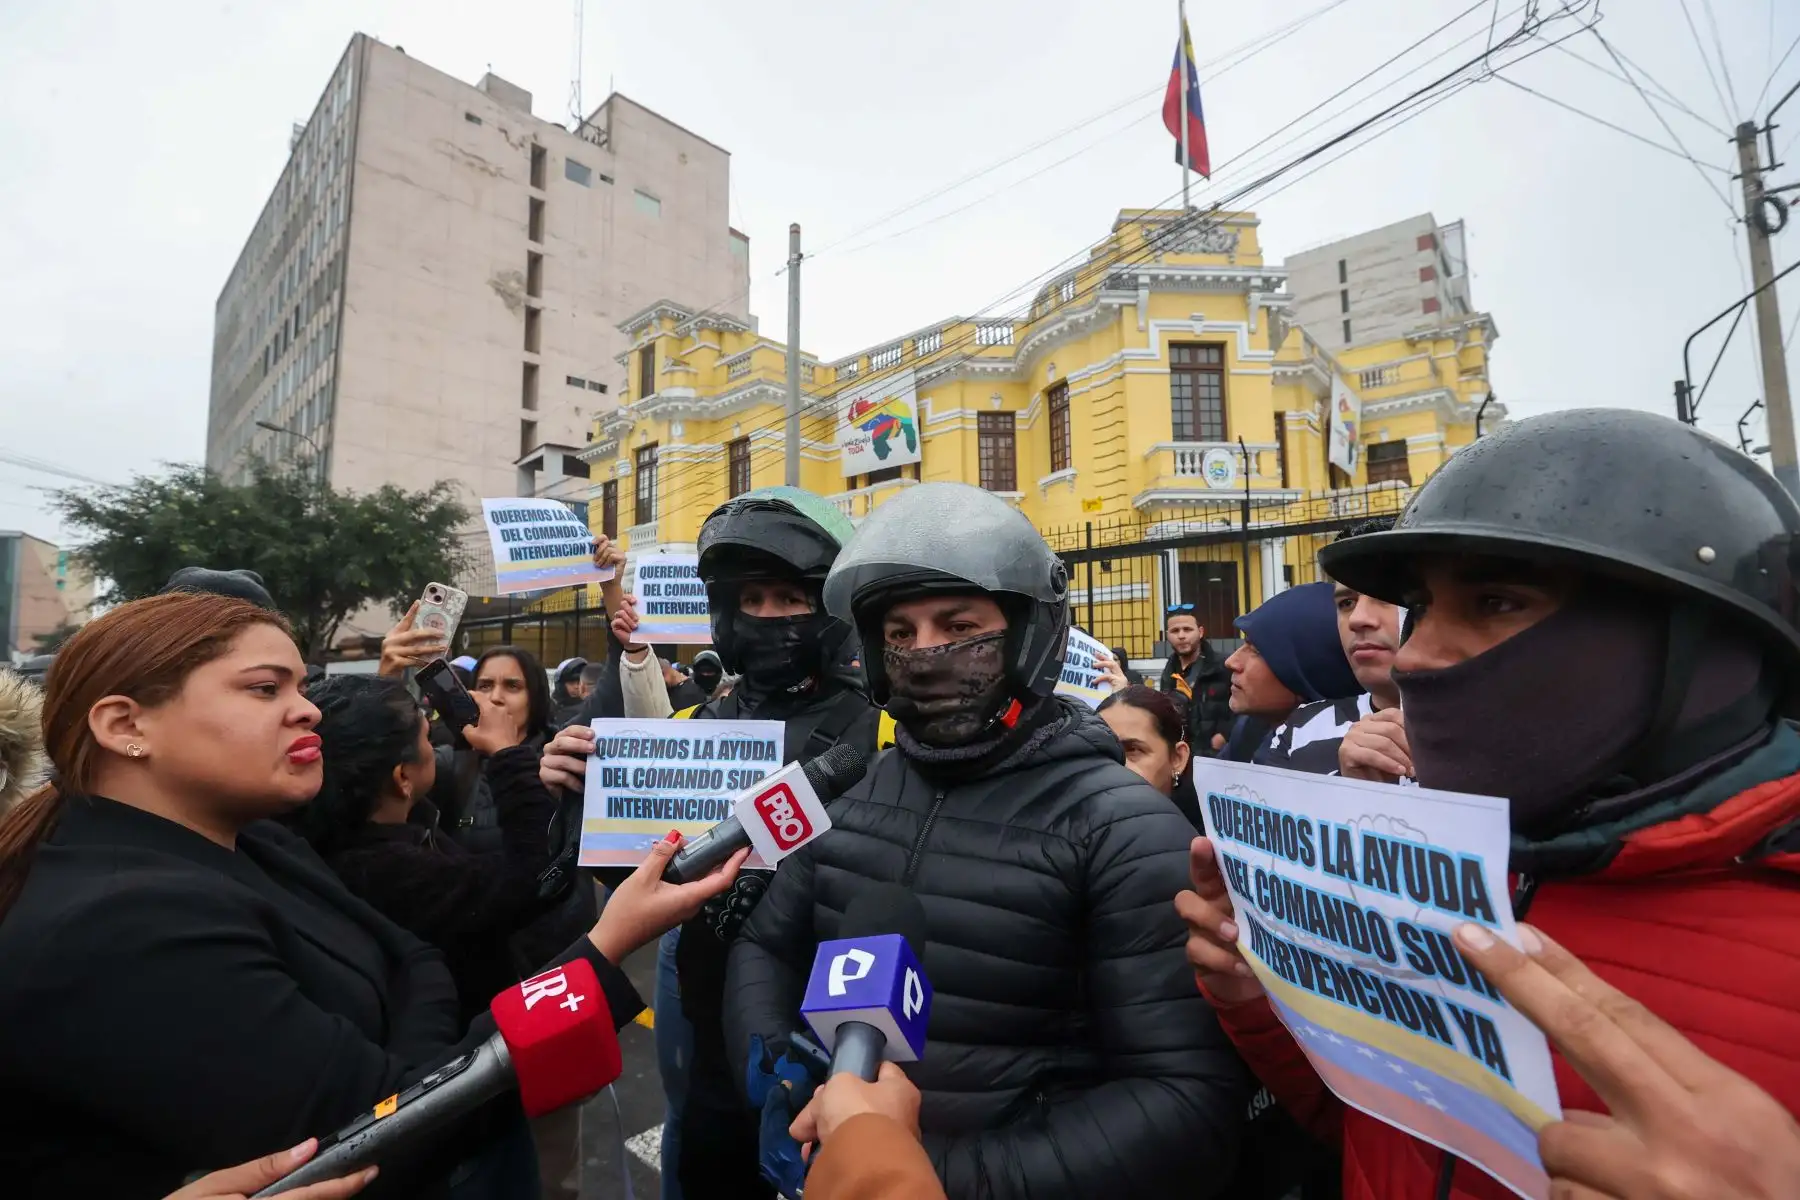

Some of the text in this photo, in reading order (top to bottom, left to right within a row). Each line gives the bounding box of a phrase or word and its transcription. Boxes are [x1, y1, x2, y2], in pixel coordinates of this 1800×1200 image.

[491, 508, 551, 526] QUEREMOS
[501, 528, 523, 543] DEL
[524, 525, 578, 541] COMANDO
[510, 543, 585, 561] INTERVENCION
[639, 565, 697, 579] QUEREMOS
[643, 583, 662, 597] DEL
[596, 738, 777, 761] QUEREMOS LA AYUDA
[602, 767, 630, 788] DEL
[633, 767, 723, 790] COMANDO
[607, 797, 729, 820] INTERVENCION
[761, 790, 803, 842] PBO
[1208, 794, 1497, 924] QUEREMOS LA AYUDA
[1222, 853, 1255, 905] DEL
[1255, 868, 1397, 963] COMANDO
[1245, 911, 1513, 1082] INTERVENCION YA
